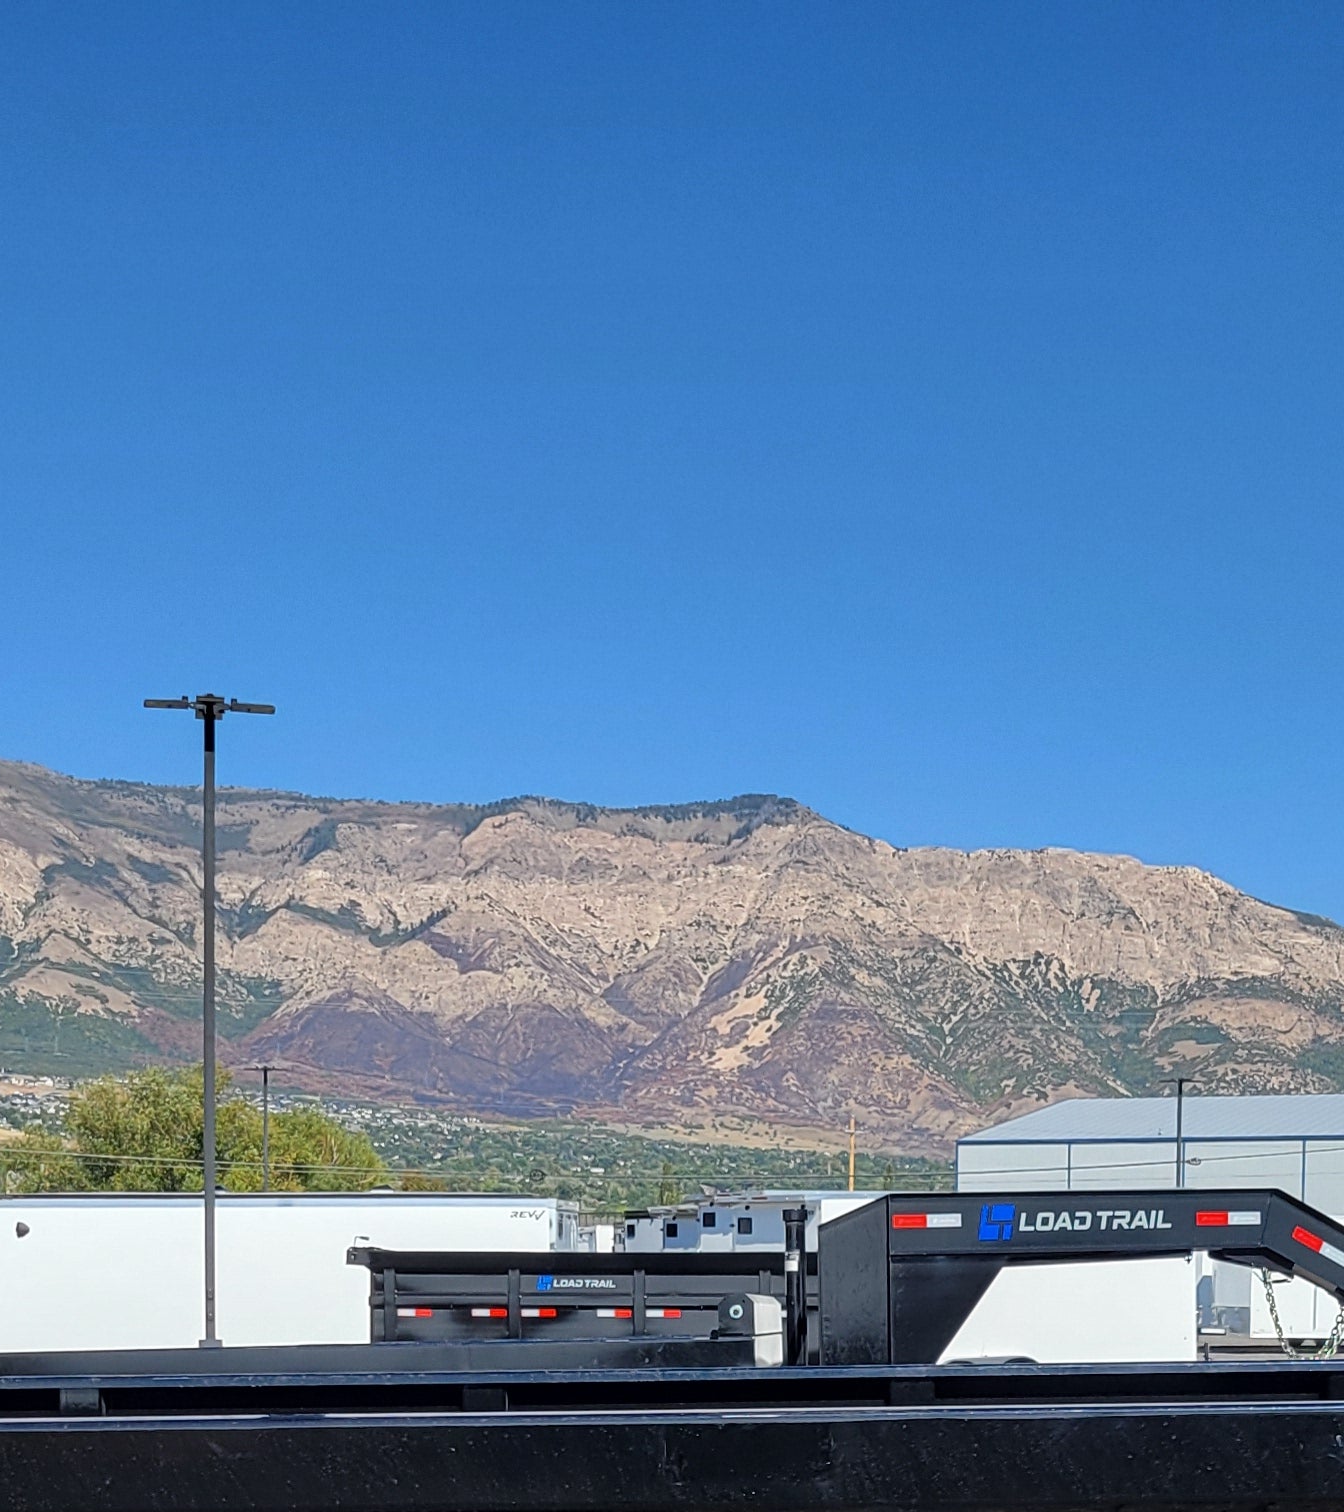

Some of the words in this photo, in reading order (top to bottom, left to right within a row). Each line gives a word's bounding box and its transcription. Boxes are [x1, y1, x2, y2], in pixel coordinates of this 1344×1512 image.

[1019, 1211, 1092, 1231] LOAD
[1097, 1210, 1172, 1230] TRAIL
[553, 1279, 584, 1288] LOAD
[584, 1279, 616, 1288] TRAIL
